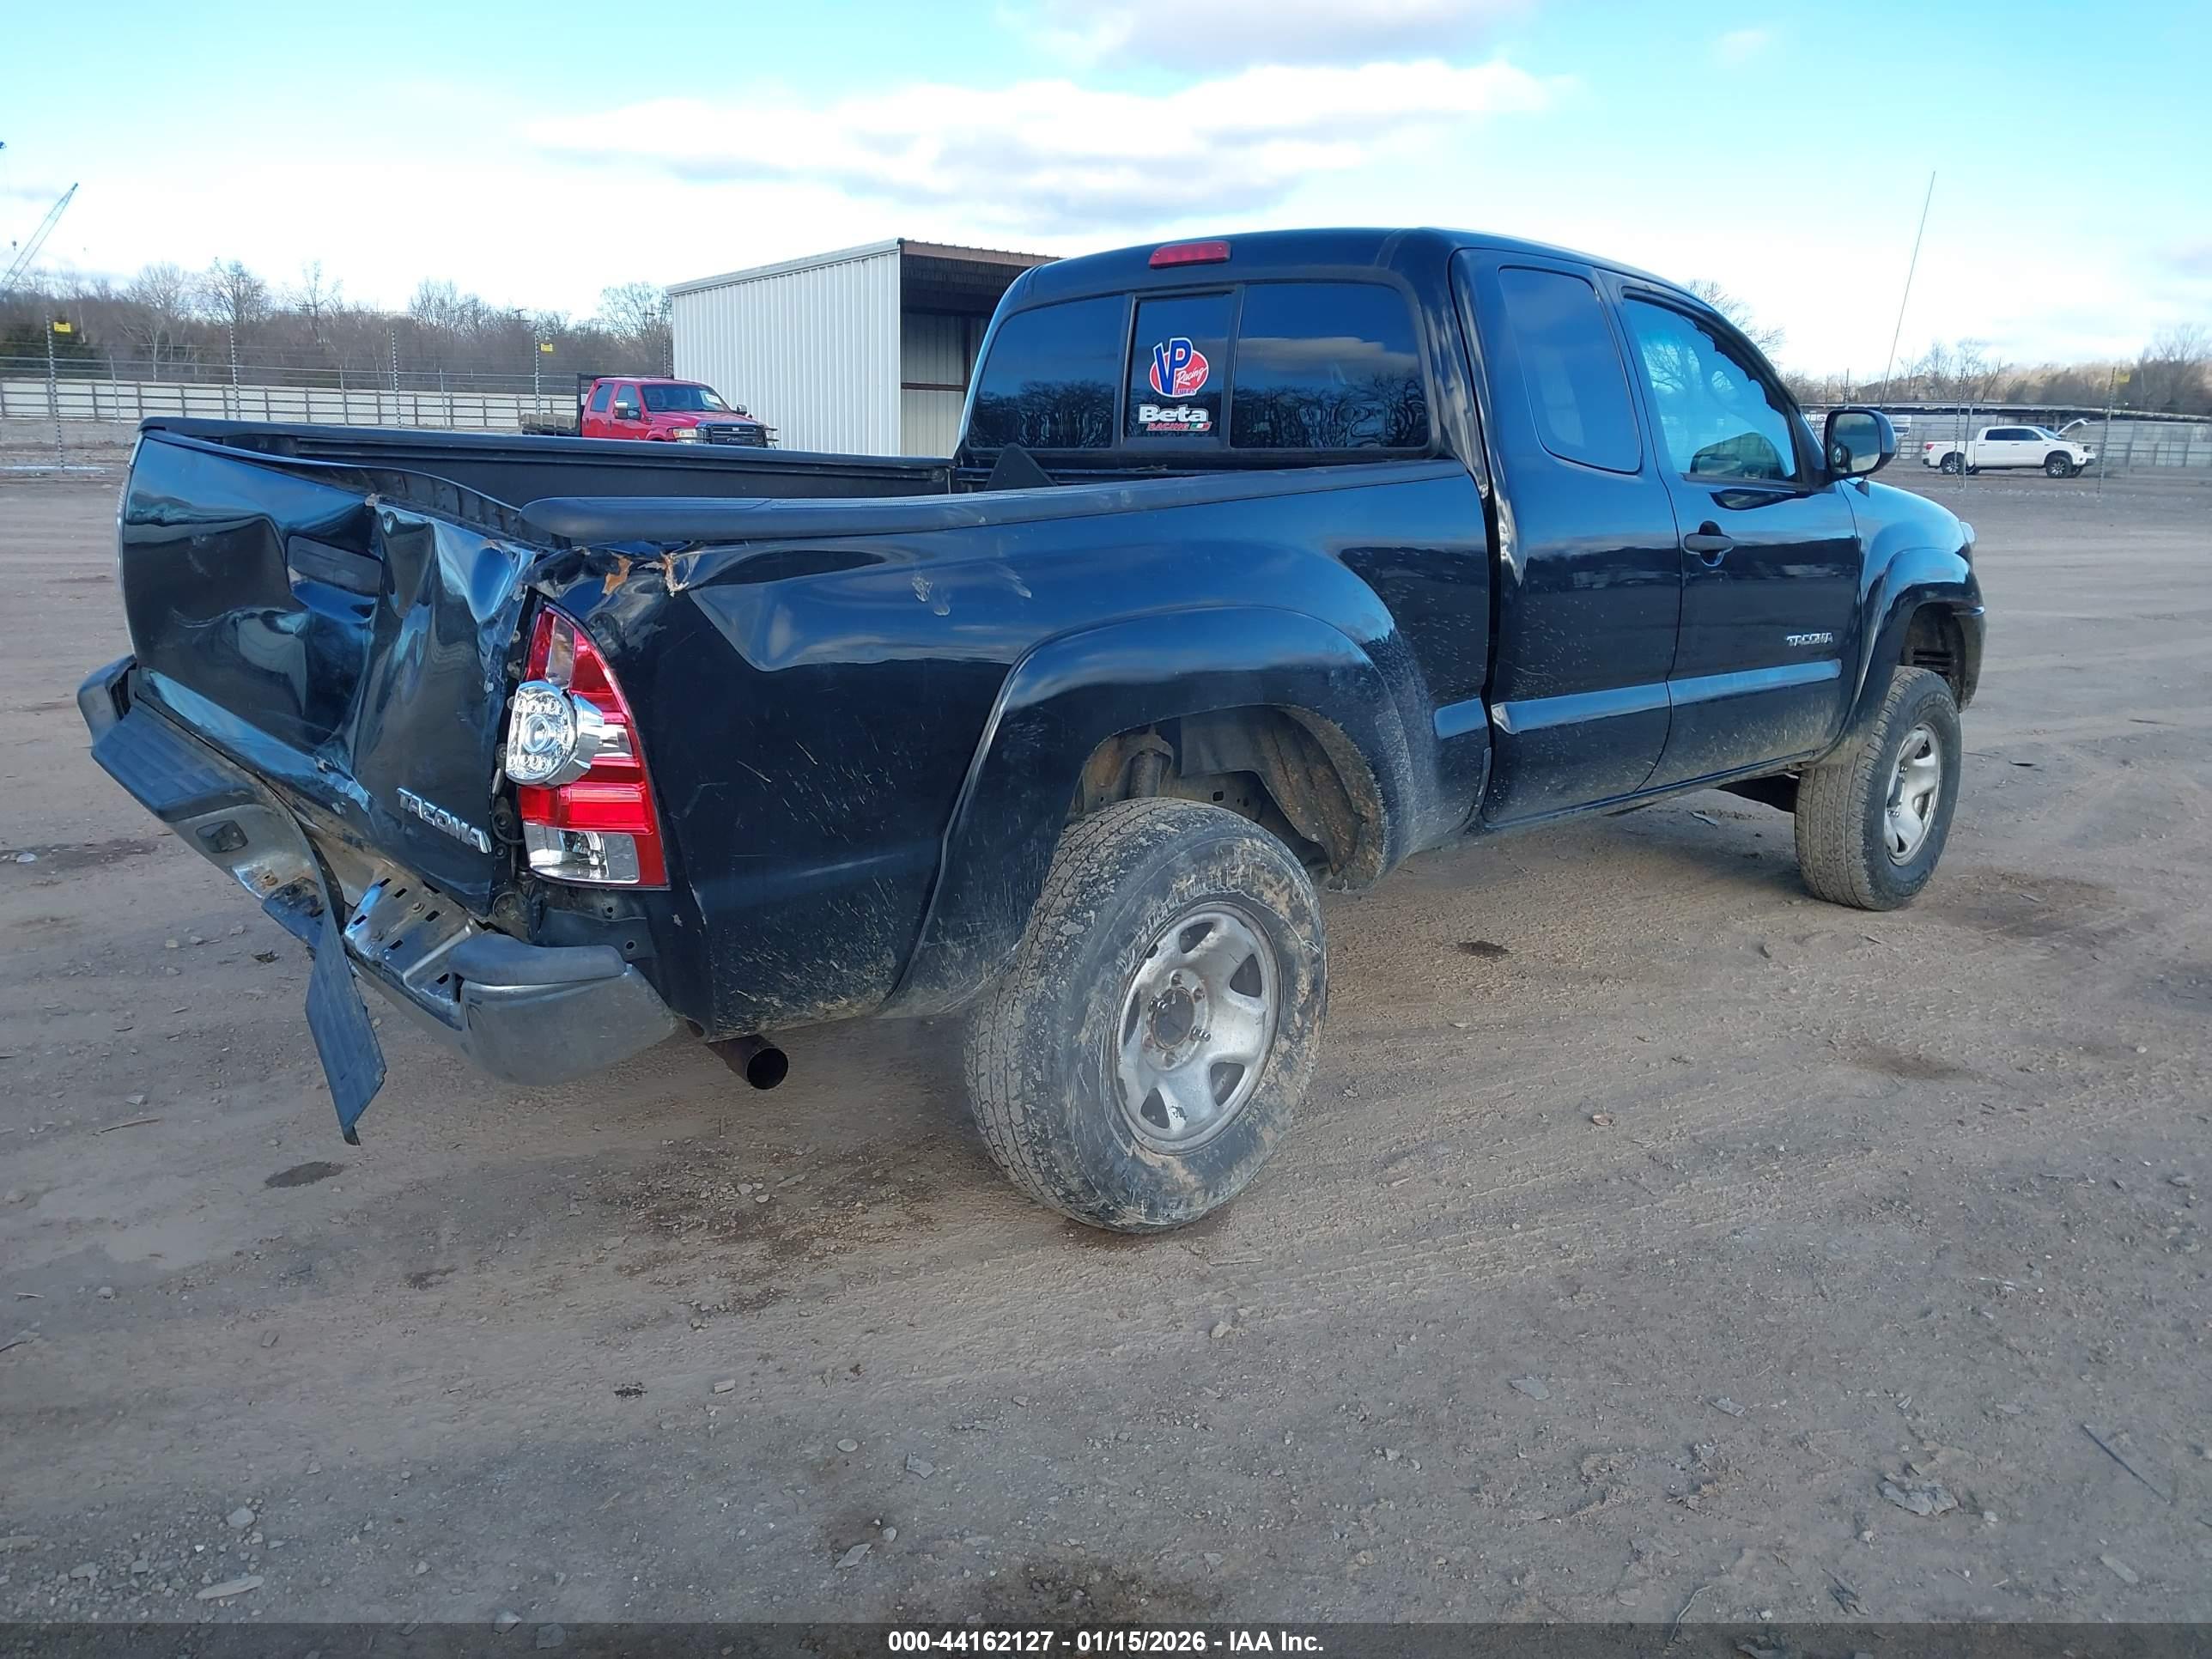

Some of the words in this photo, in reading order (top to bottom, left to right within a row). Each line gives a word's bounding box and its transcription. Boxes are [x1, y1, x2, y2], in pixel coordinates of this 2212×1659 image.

[1153, 337, 1194, 396] VP
[1176, 367, 1208, 389] Racing
[1139, 405, 1207, 422] Beta
[1786, 632, 1833, 647] TACOMA
[397, 787, 492, 854] TACOMA
